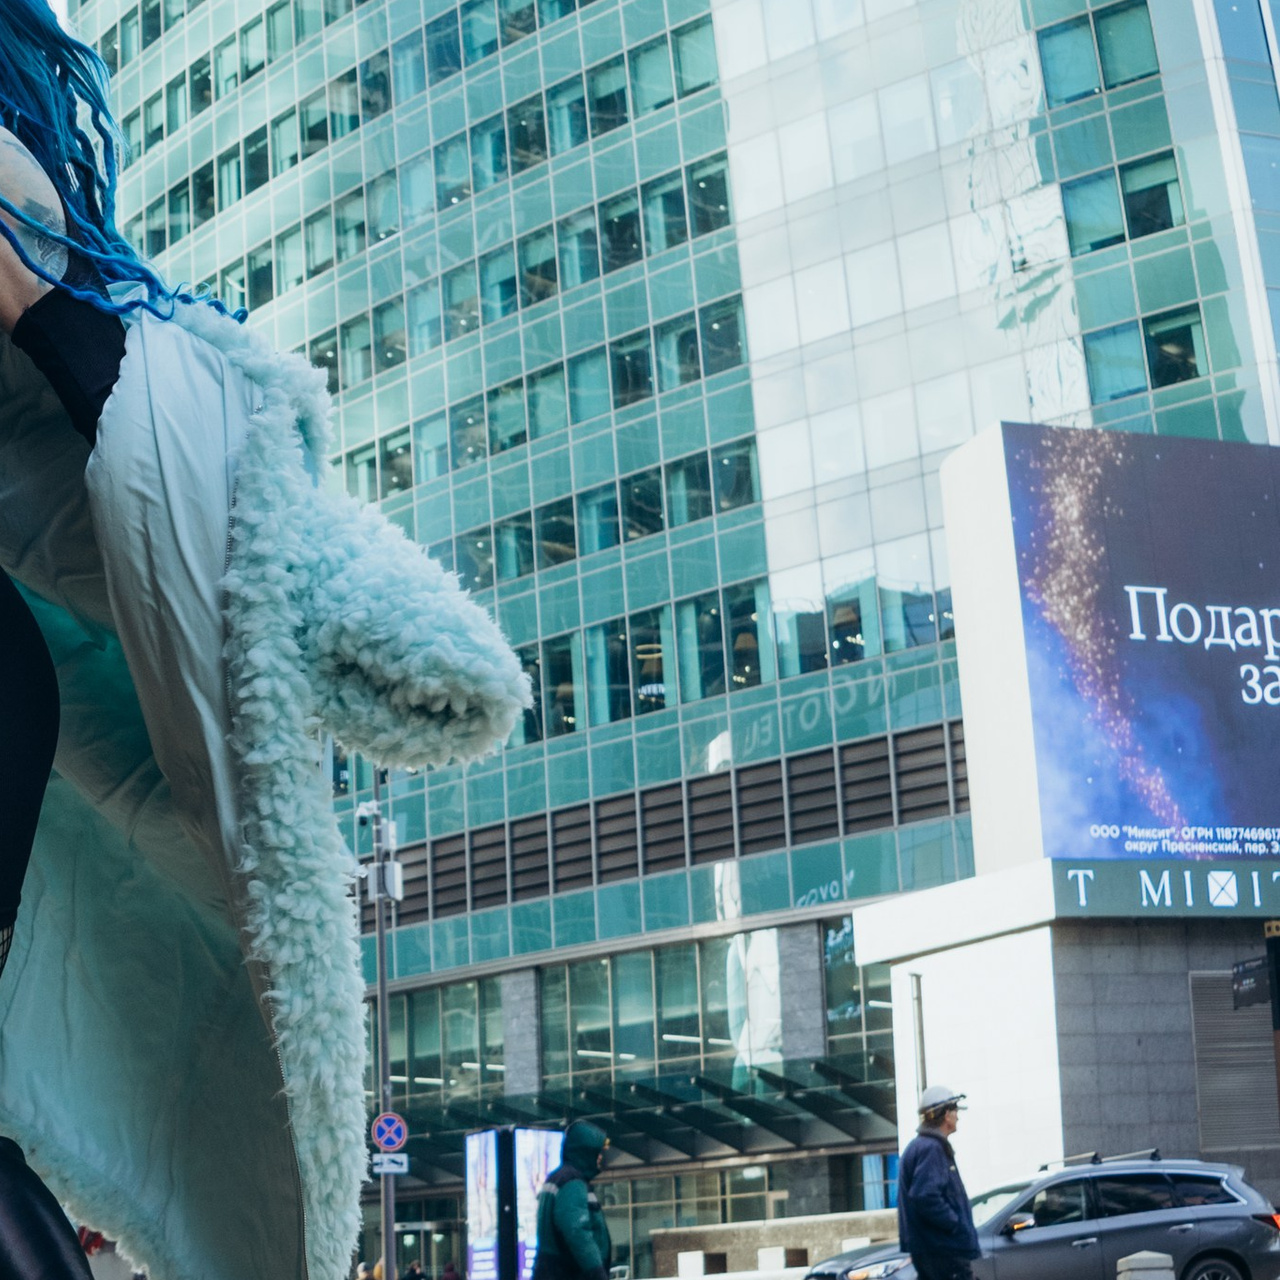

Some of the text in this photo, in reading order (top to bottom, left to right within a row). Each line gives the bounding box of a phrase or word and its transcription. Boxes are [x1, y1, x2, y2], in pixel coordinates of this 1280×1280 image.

[1090, 824, 1120, 839] ООО
[1181, 826, 1213, 841] ОГРН
[1124, 840, 1158, 854] округ
